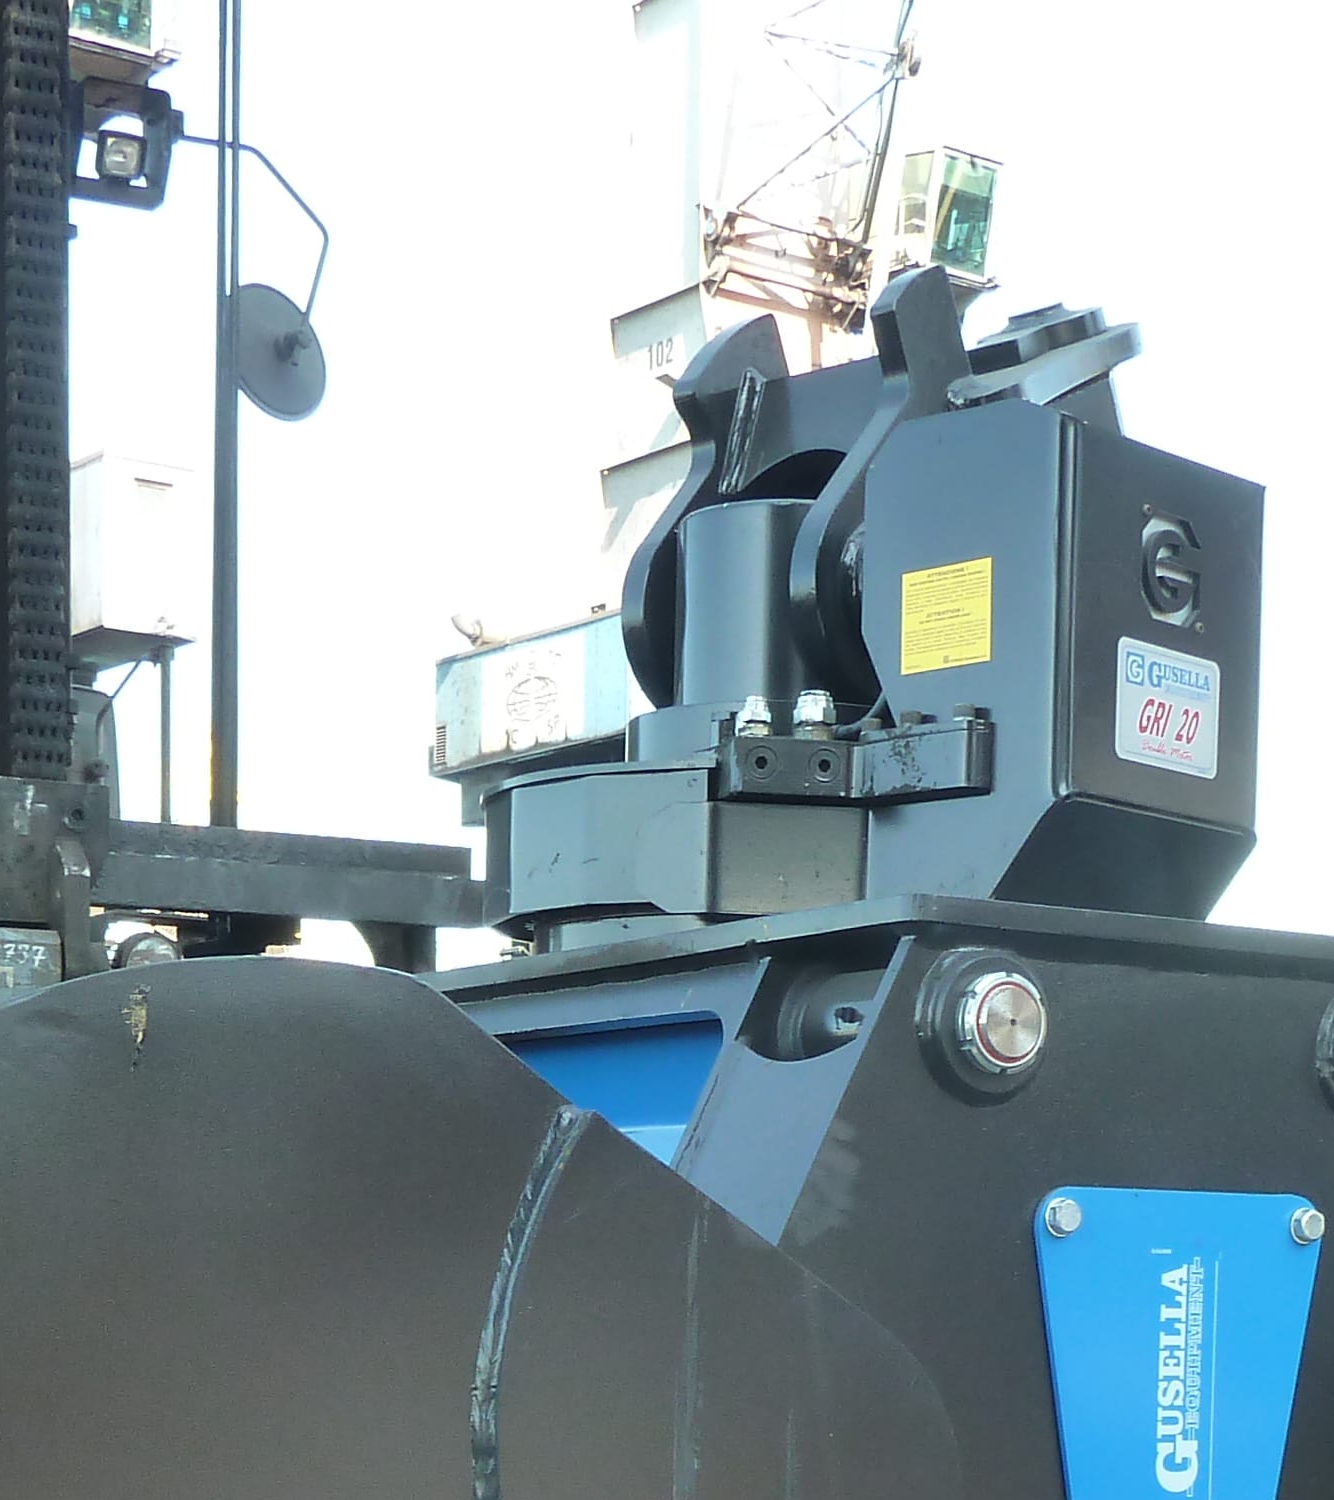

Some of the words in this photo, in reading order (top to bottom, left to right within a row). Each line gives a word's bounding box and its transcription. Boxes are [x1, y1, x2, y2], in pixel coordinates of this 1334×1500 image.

[648, 337, 673, 371] 102
[1148, 661, 1211, 692] GUSELLA
[1139, 698, 1173, 738] GRI
[1175, 708, 1200, 745] 20
[1155, 1264, 1198, 1493] GUSELLA
